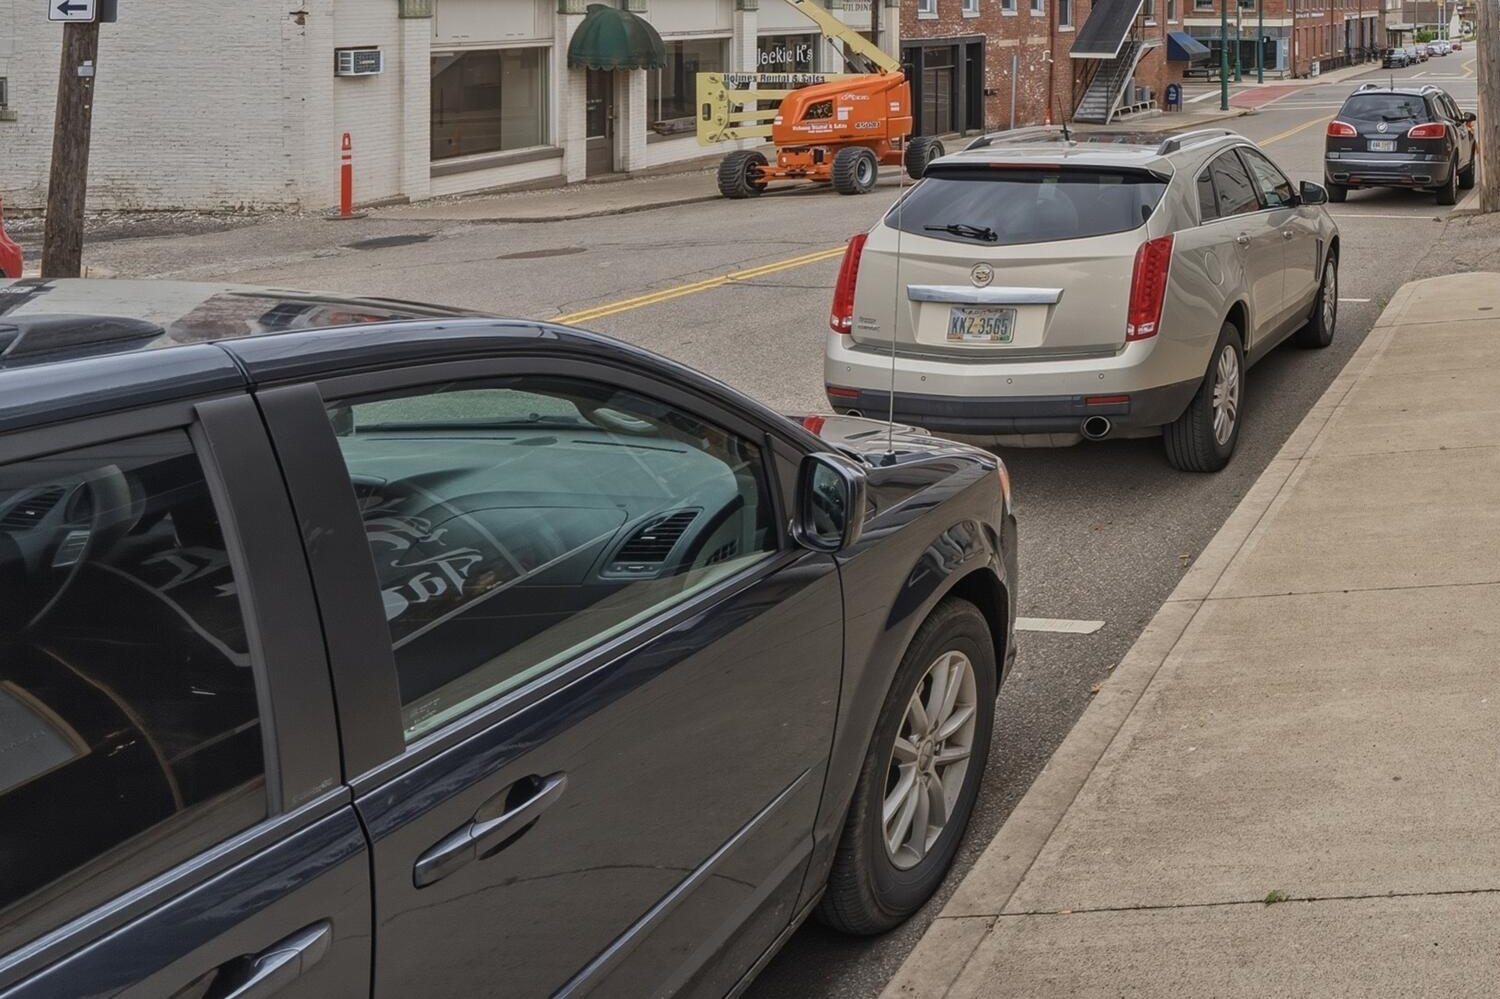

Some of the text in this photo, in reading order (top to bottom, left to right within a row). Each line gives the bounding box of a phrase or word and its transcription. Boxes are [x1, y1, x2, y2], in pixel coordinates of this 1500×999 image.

[756, 44, 793, 67] Jackie
[723, 73, 757, 83] Holmes
[760, 74, 790, 82] Rental
[800, 74, 825, 83] Sales
[952, 316, 975, 335] KKZ
